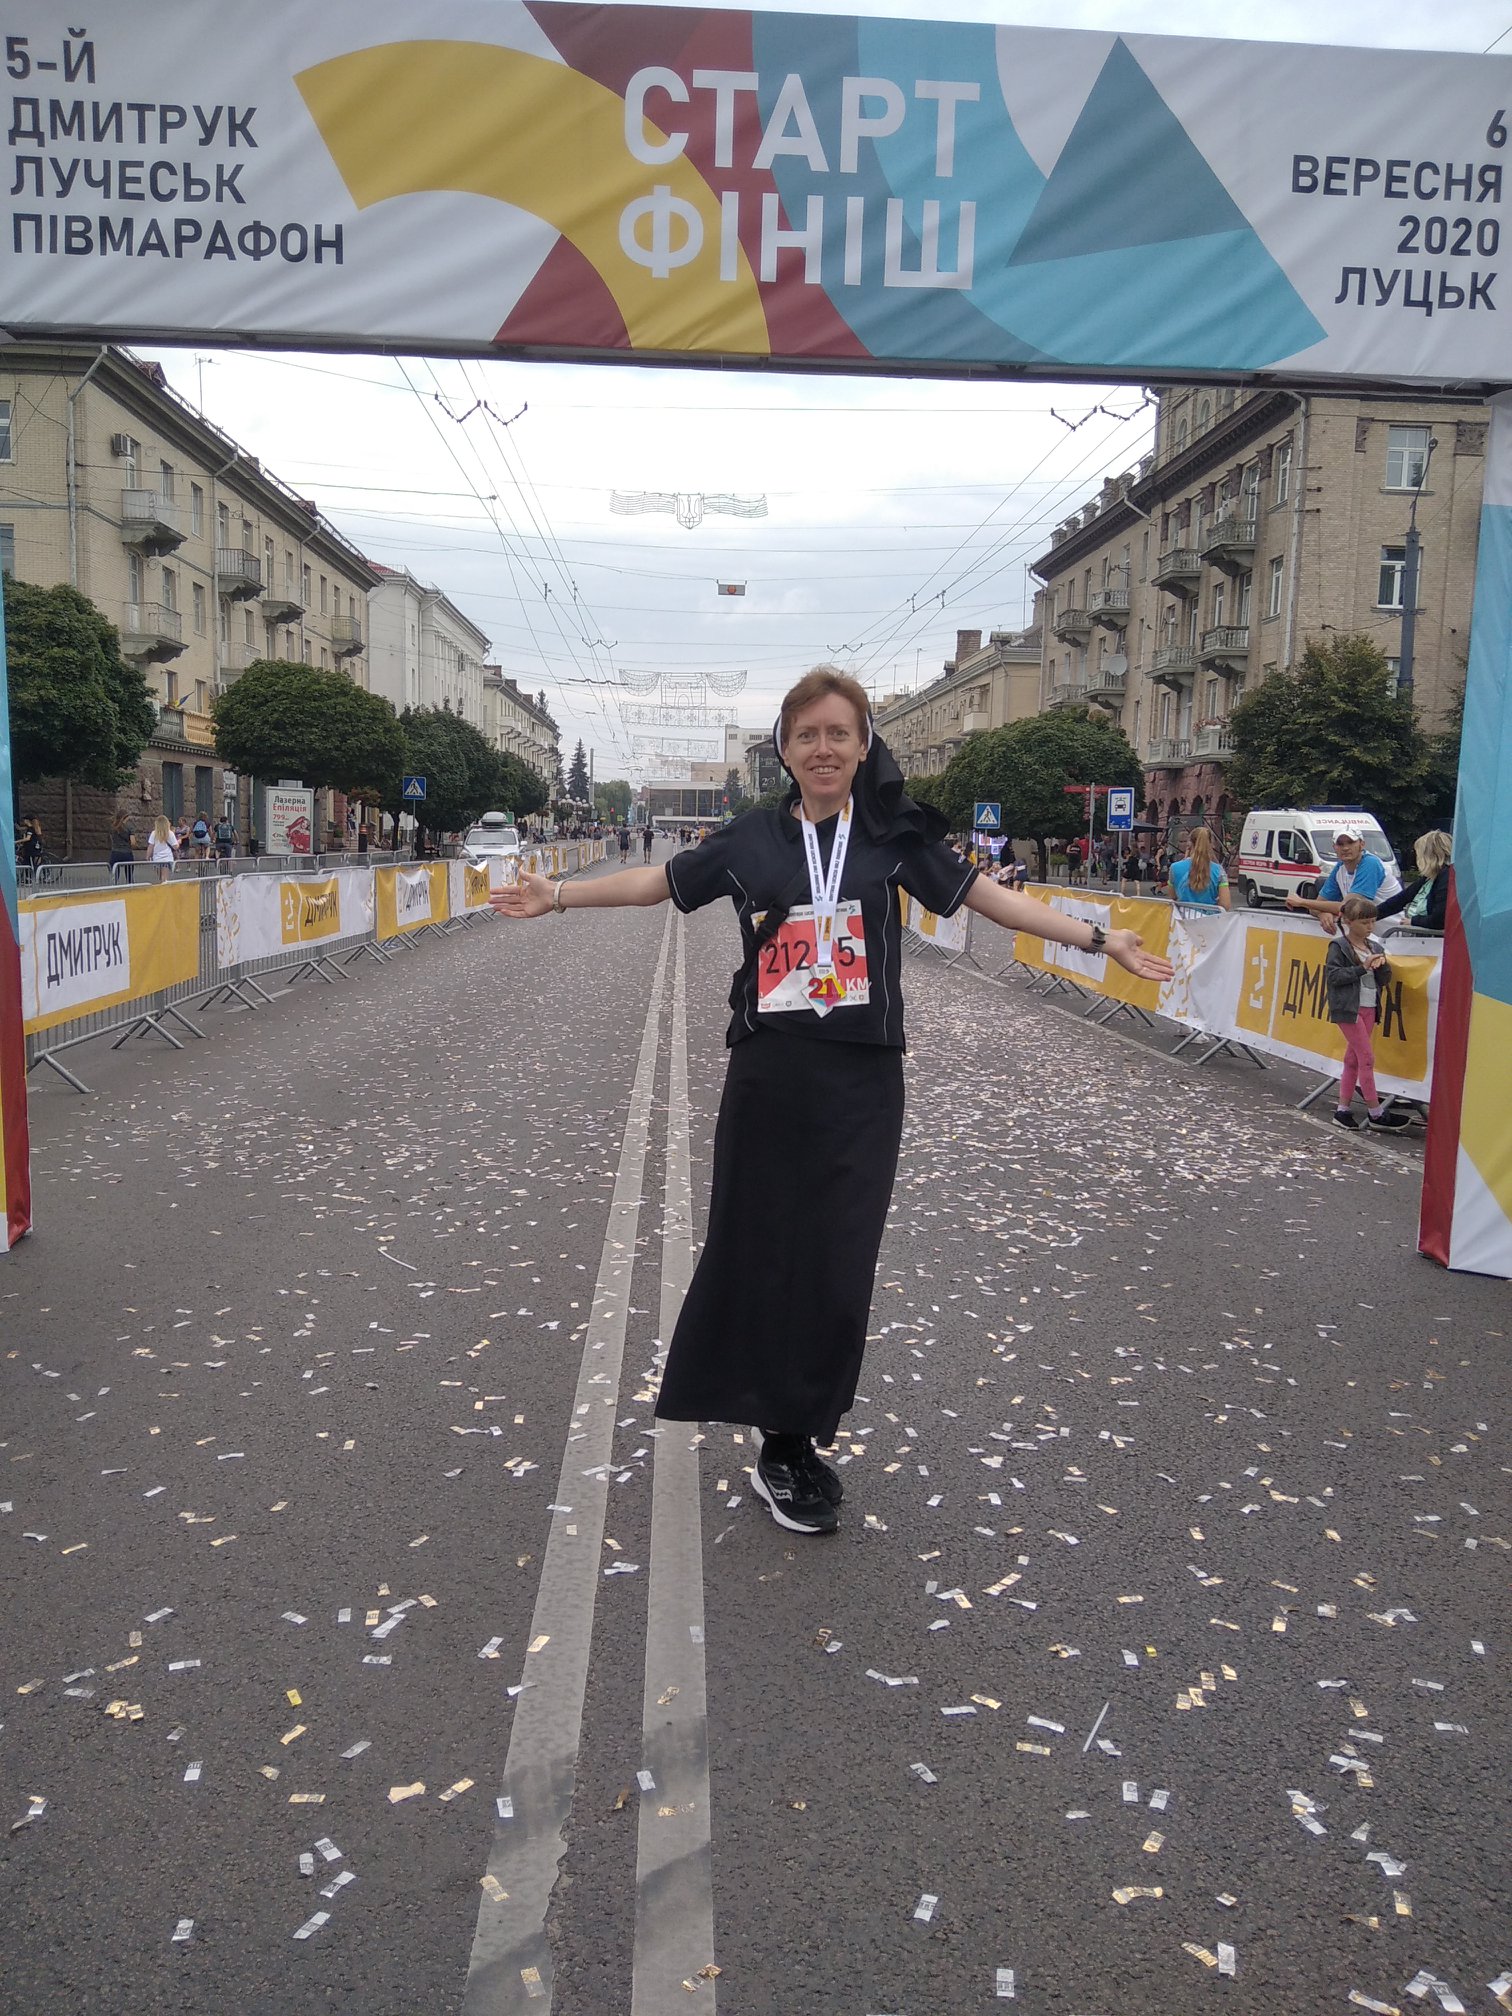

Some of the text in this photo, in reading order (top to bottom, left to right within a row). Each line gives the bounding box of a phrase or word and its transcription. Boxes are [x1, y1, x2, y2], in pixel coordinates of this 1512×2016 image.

[6, 27, 96, 84] 5-Й
[8, 97, 259, 149] ДМИТРУК
[623, 66, 981, 178] СТАРТ
[1487, 109, 1508, 149] 6
[11, 155, 247, 205] ЛУЧЕСЬК
[1292, 154, 1503, 204] ВЕРЕСНЯ
[13, 213, 344, 265] ПІВМАРАФОН
[618, 185, 977, 290] ФІНІШ
[1397, 215, 1500, 257] 2020
[1335, 266, 1498, 318] ЛУЦЬК
[272, 803, 307, 813] Епіляція
[274, 795, 306, 805] Лазерна
[47, 922, 122, 989] ДМИТРУК
[765, 935, 856, 977] 2125
[808, 977, 841, 999] 21
[1282, 959, 1407, 1041] ДМИК
